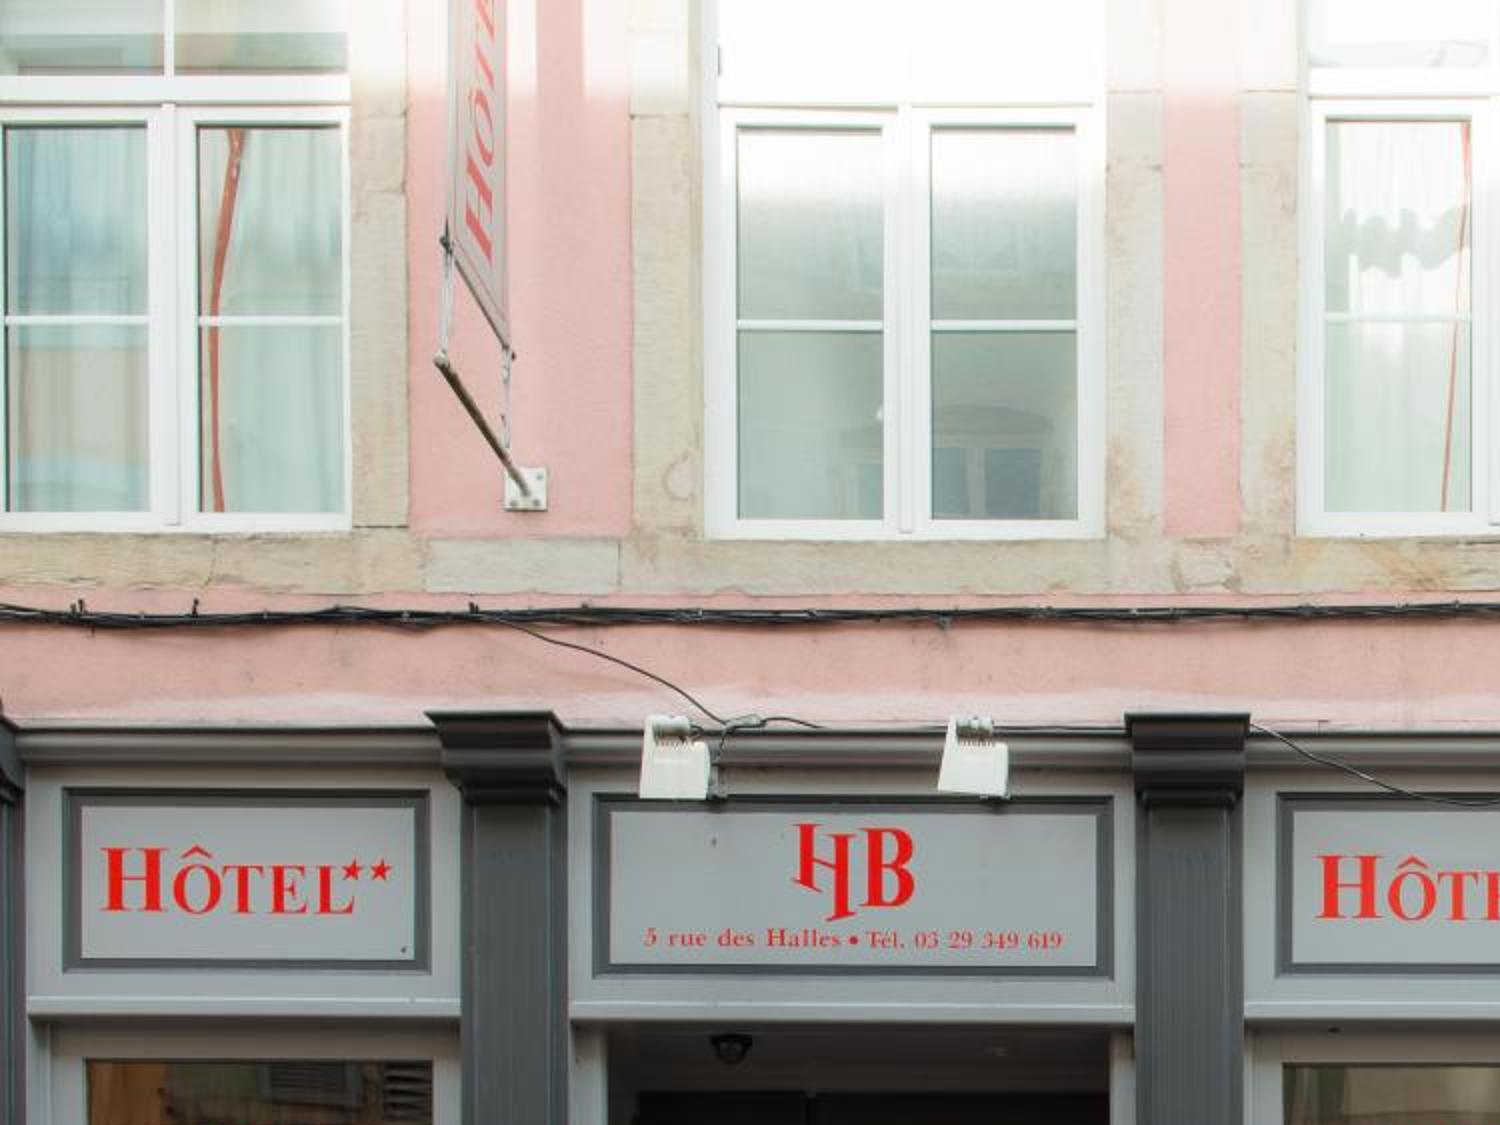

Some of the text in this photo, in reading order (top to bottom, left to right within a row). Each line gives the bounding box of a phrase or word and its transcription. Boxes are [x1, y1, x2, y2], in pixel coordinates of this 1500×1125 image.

[667, 932, 708, 948] rue
[716, 927, 755, 948] des
[766, 927, 841, 948] Halles
[866, 930, 905, 950] Tél.
[948, 930, 975, 950] 29
[983, 930, 1021, 950] 349
[1026, 930, 1065, 950] 619
